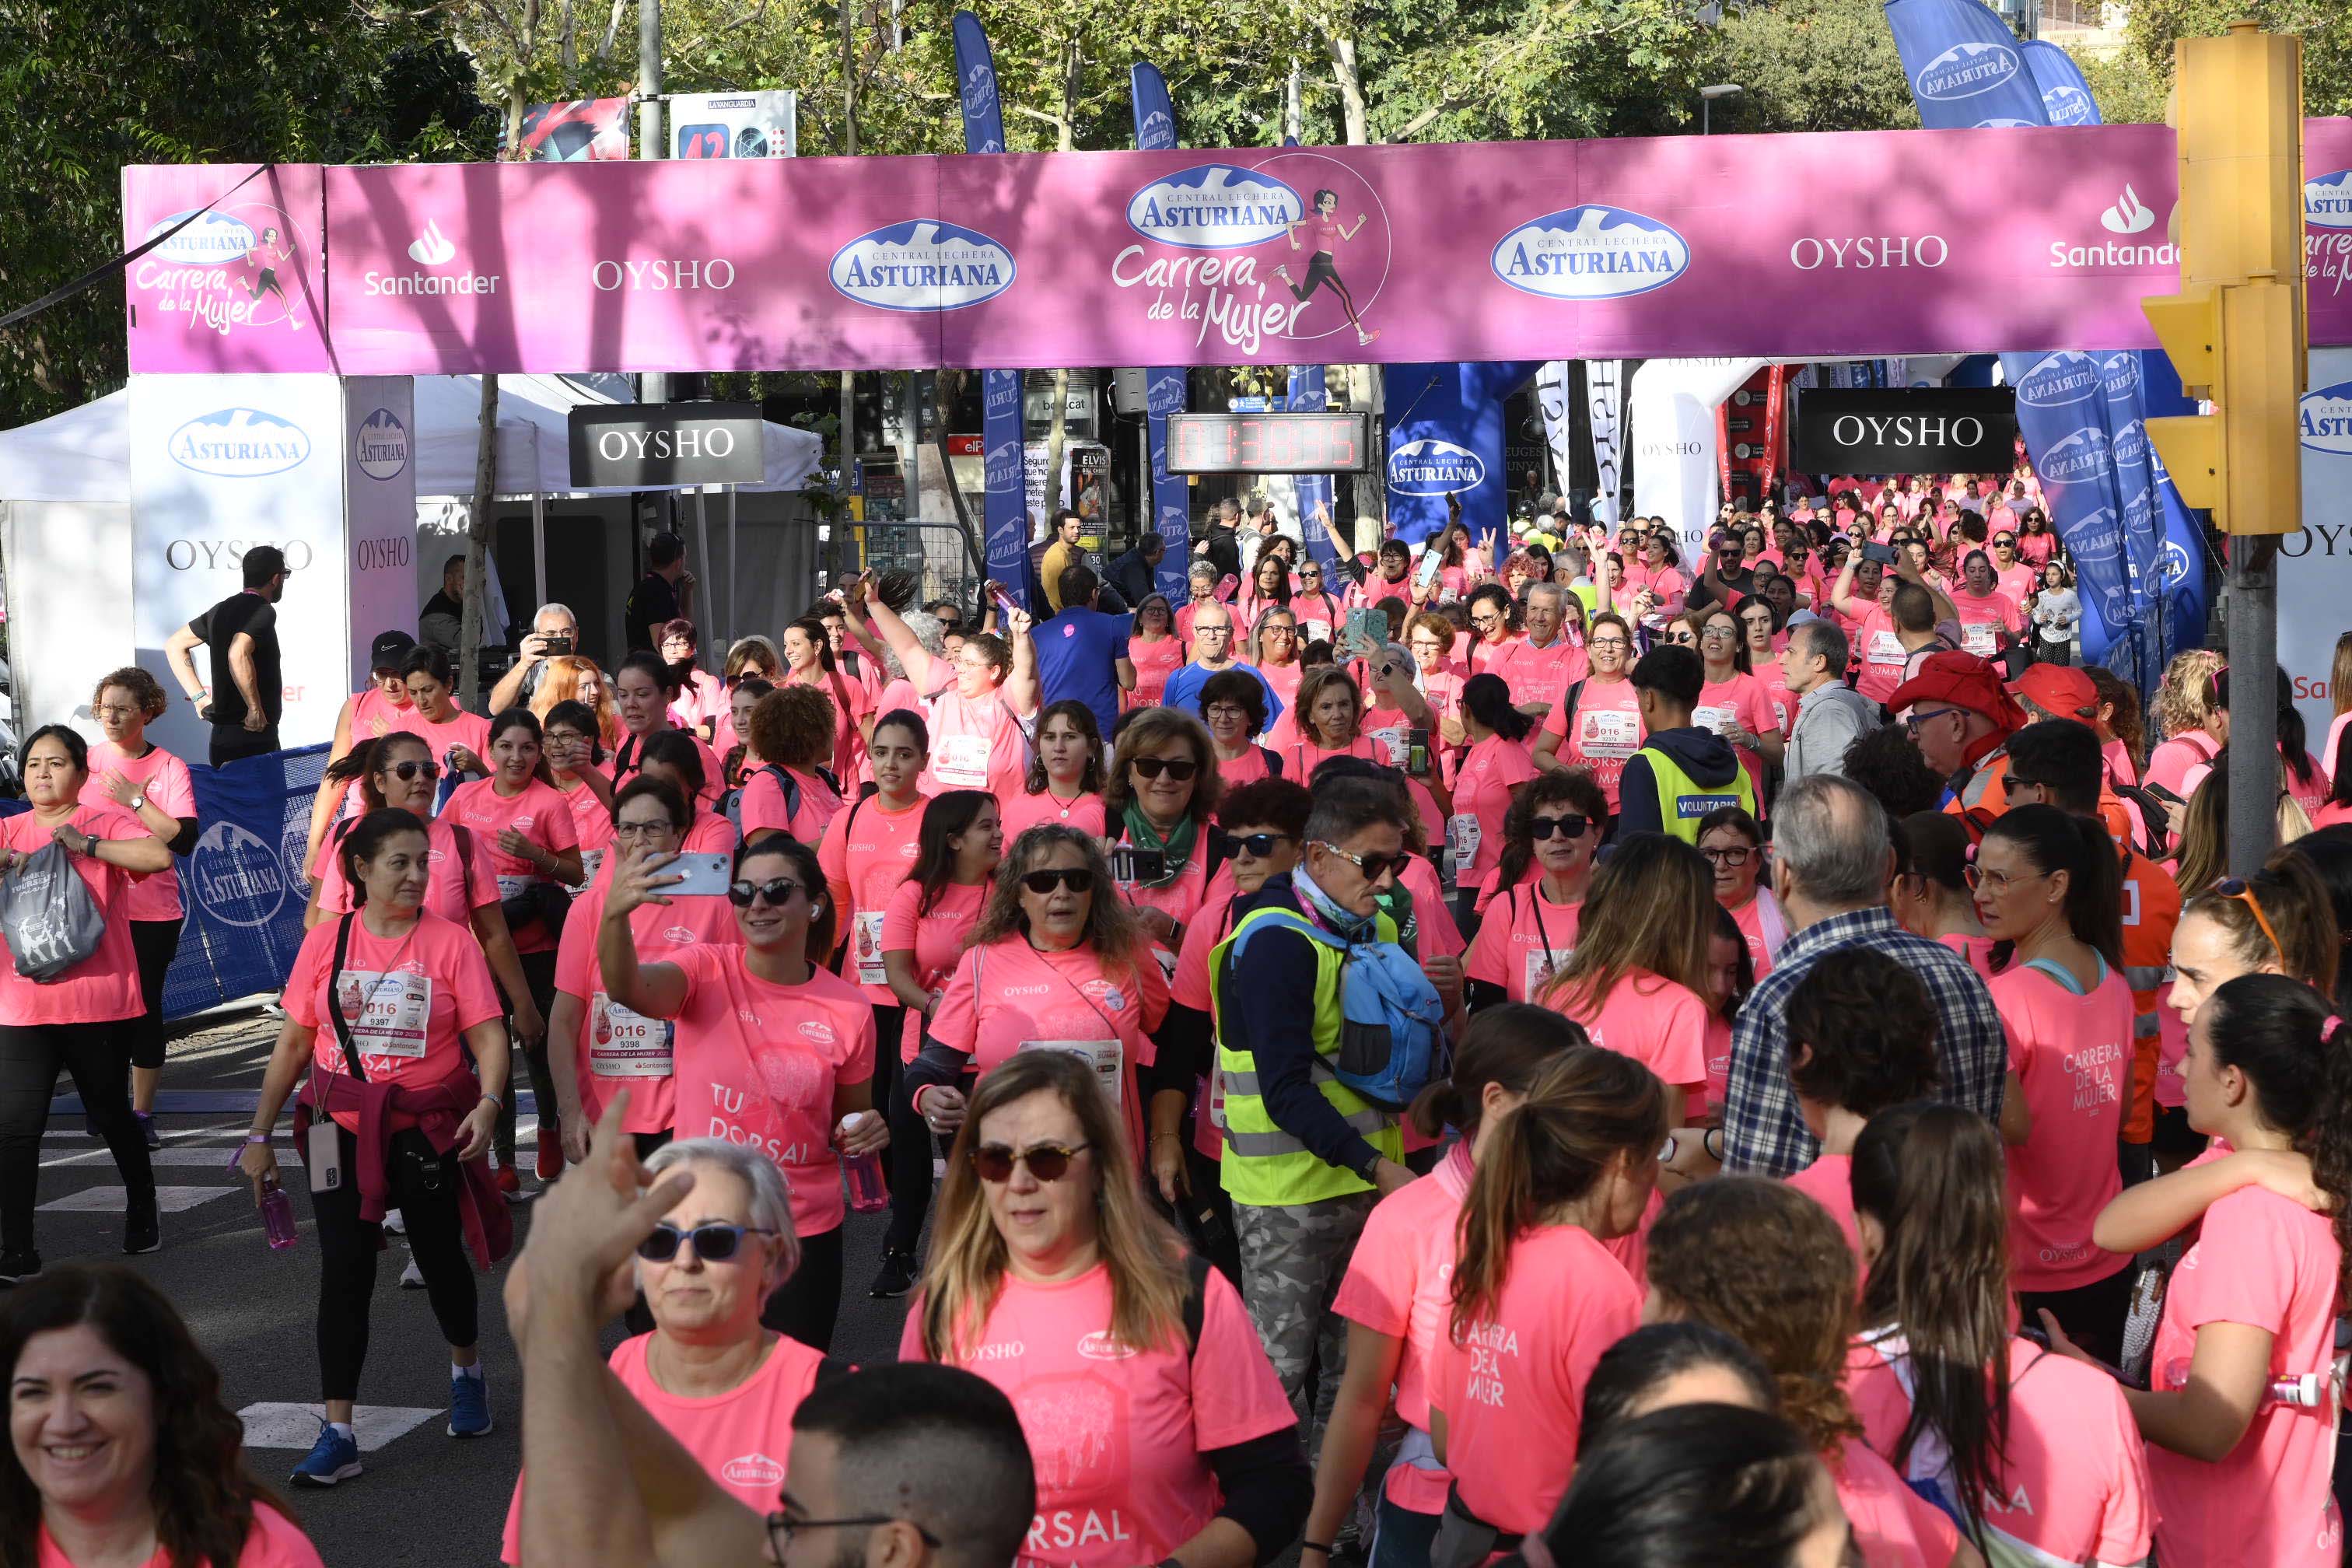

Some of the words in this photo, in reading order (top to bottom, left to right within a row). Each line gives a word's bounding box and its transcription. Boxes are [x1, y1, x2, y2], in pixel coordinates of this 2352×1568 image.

[1140, 196, 1290, 228] ASTURIANA
[872, 250, 931, 261] CENTRAL
[937, 250, 996, 261] LECHERA
[1538, 237, 1599, 248] CENTRAL
[1605, 236, 1667, 247] LECHERA
[1790, 236, 1948, 270] OYSHO
[2049, 242, 2182, 267] Santand
[844, 254, 1002, 289] ASTURIANA
[1111, 245, 1257, 288] Carrera
[1507, 242, 1674, 277] ASTURIANA
[136, 261, 226, 290] Carrera
[365, 271, 499, 296] Santander
[592, 259, 735, 291] OYSHO
[159, 292, 175, 311] de
[180, 292, 191, 311] la
[190, 289, 261, 335] Mujer
[1148, 290, 1174, 320] de
[1181, 291, 1199, 320] la
[1196, 280, 1312, 355] Mujer
[599, 428, 734, 460] OYSHO
[1833, 415, 1983, 446] OYSHO
[180, 435, 299, 459] ASTURIANA
[360, 439, 404, 463] ASTURIANA
[1083, 456, 1106, 464] ELVIS
[1643, 442, 1701, 455] OYSHO
[1025, 478, 1048, 487] quiere
[1390, 463, 1478, 483] ASTURIANA
[358, 536, 409, 571] OYSHO
[2278, 525, 2352, 557] OY
[166, 540, 313, 571] OYSO
[1870, 666, 1898, 676] SUMA
[465, 812, 492, 822] OYSHO
[848, 844, 876, 852] OYSHO
[201, 845, 281, 905] ASTURIANA
[1004, 984, 1048, 996] OYSHO
[366, 1003, 397, 1015] 016
[614, 1025, 646, 1037] 016
[2063, 1042, 2121, 1073] CARRERA
[2076, 1069, 2091, 1090] DE
[2095, 1064, 2112, 1084] LA
[710, 1083, 744, 1115] TU
[2073, 1083, 2116, 1111] MUJER
[1027, 1509, 1129, 1552] RSAL
